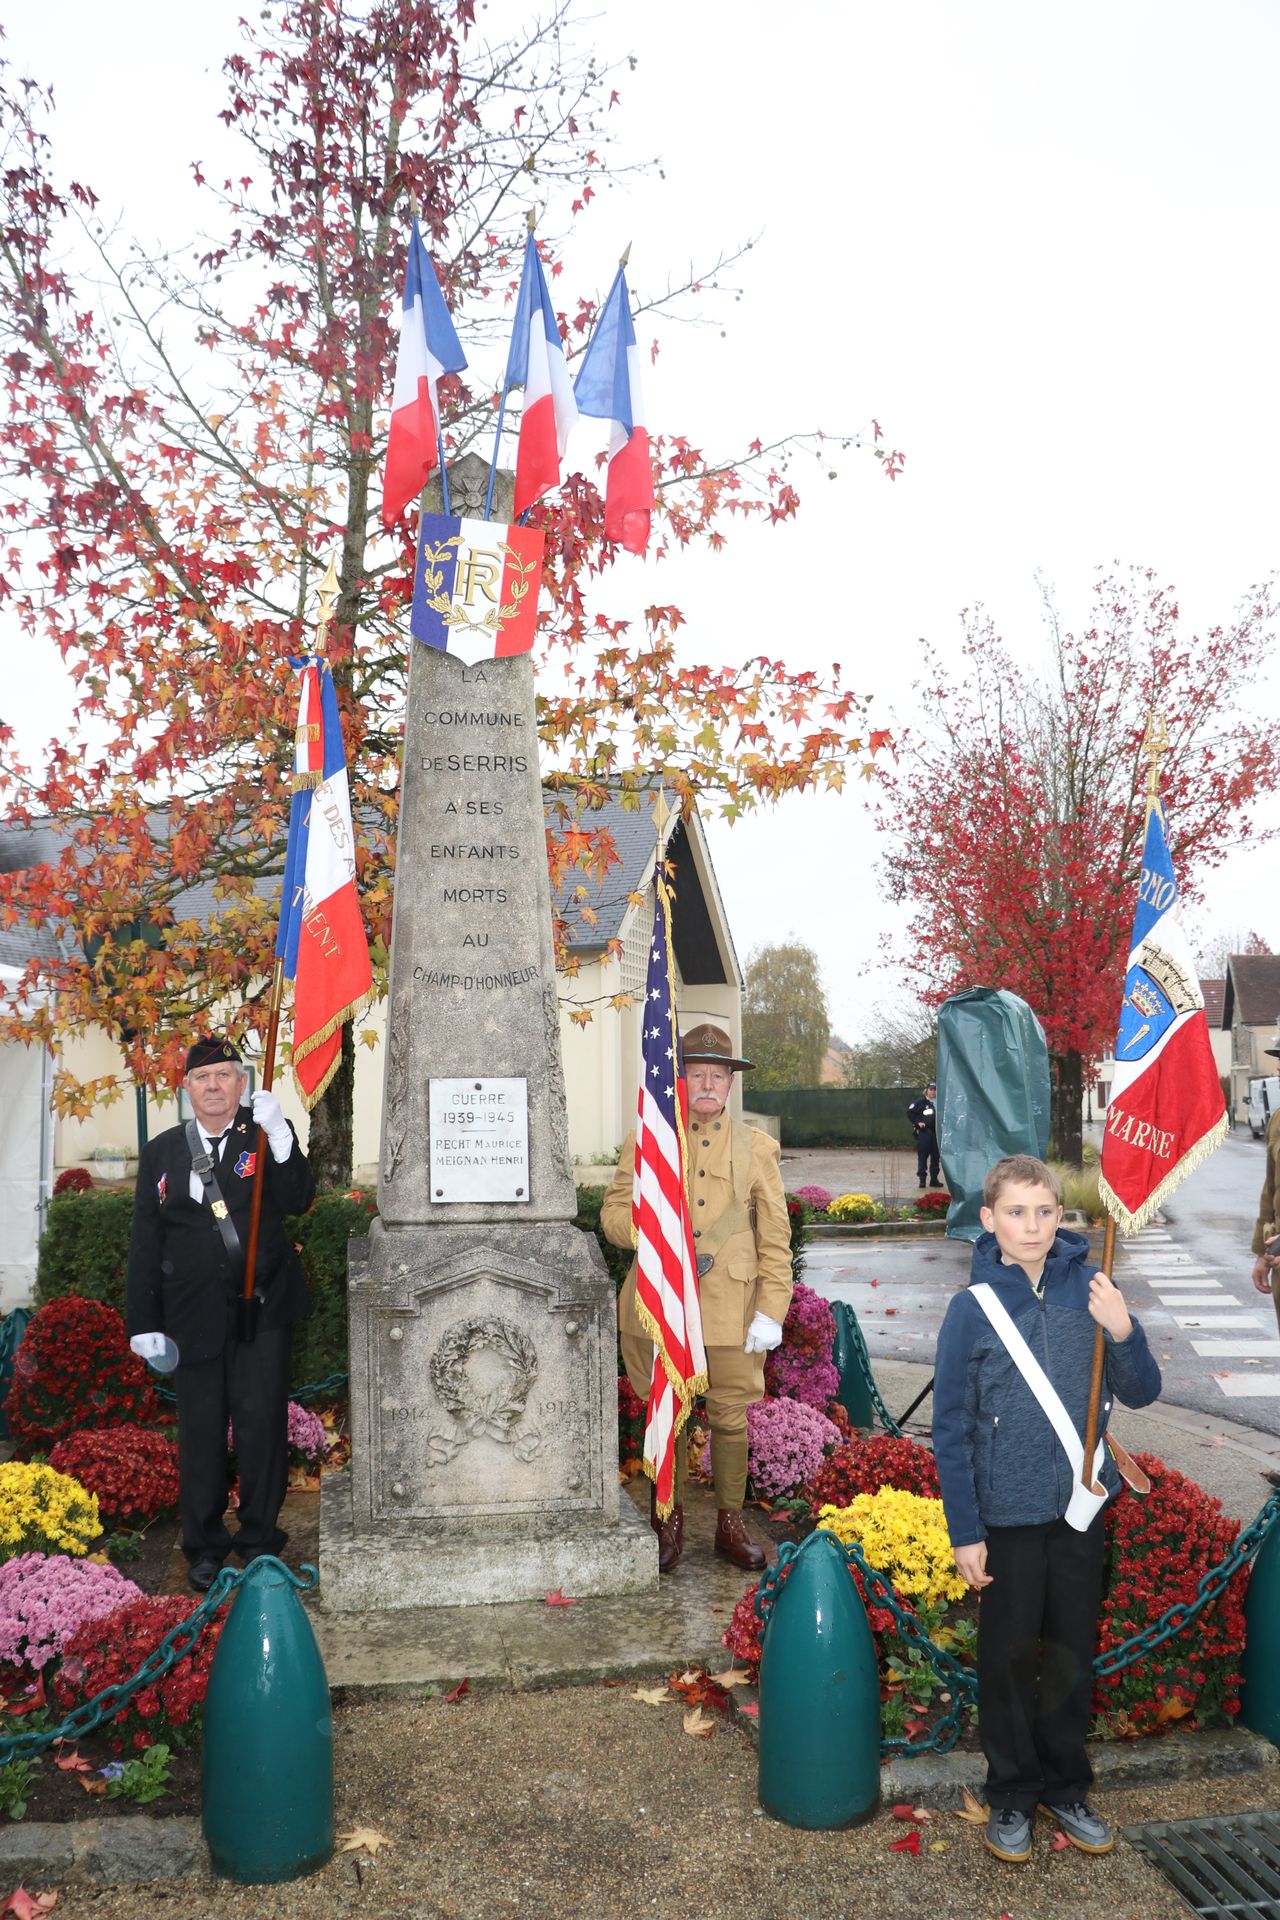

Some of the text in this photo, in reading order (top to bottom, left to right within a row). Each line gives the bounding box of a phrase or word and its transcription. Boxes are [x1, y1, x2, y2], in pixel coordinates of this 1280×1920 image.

[461, 669, 488, 683] LA
[424, 711, 524, 727] COMMUNE
[421, 754, 528, 772] DE SERRIS
[445, 801, 505, 815] A SES
[323, 804, 350, 849] DES
[431, 844, 520, 859] ENFANTS
[443, 888, 508, 903] MORTS
[462, 933, 489, 948] AU
[452, 1093, 506, 1105] GUERRE
[443, 1111, 515, 1123] 1939-1945
[1107, 1104, 1175, 1159] MARNE
[436, 1139, 471, 1150] RECHT
[436, 1156, 523, 1166] MEIGNAN HENRI
[390, 1406, 432, 1421] 1914
[537, 1400, 579, 1416] 1918
